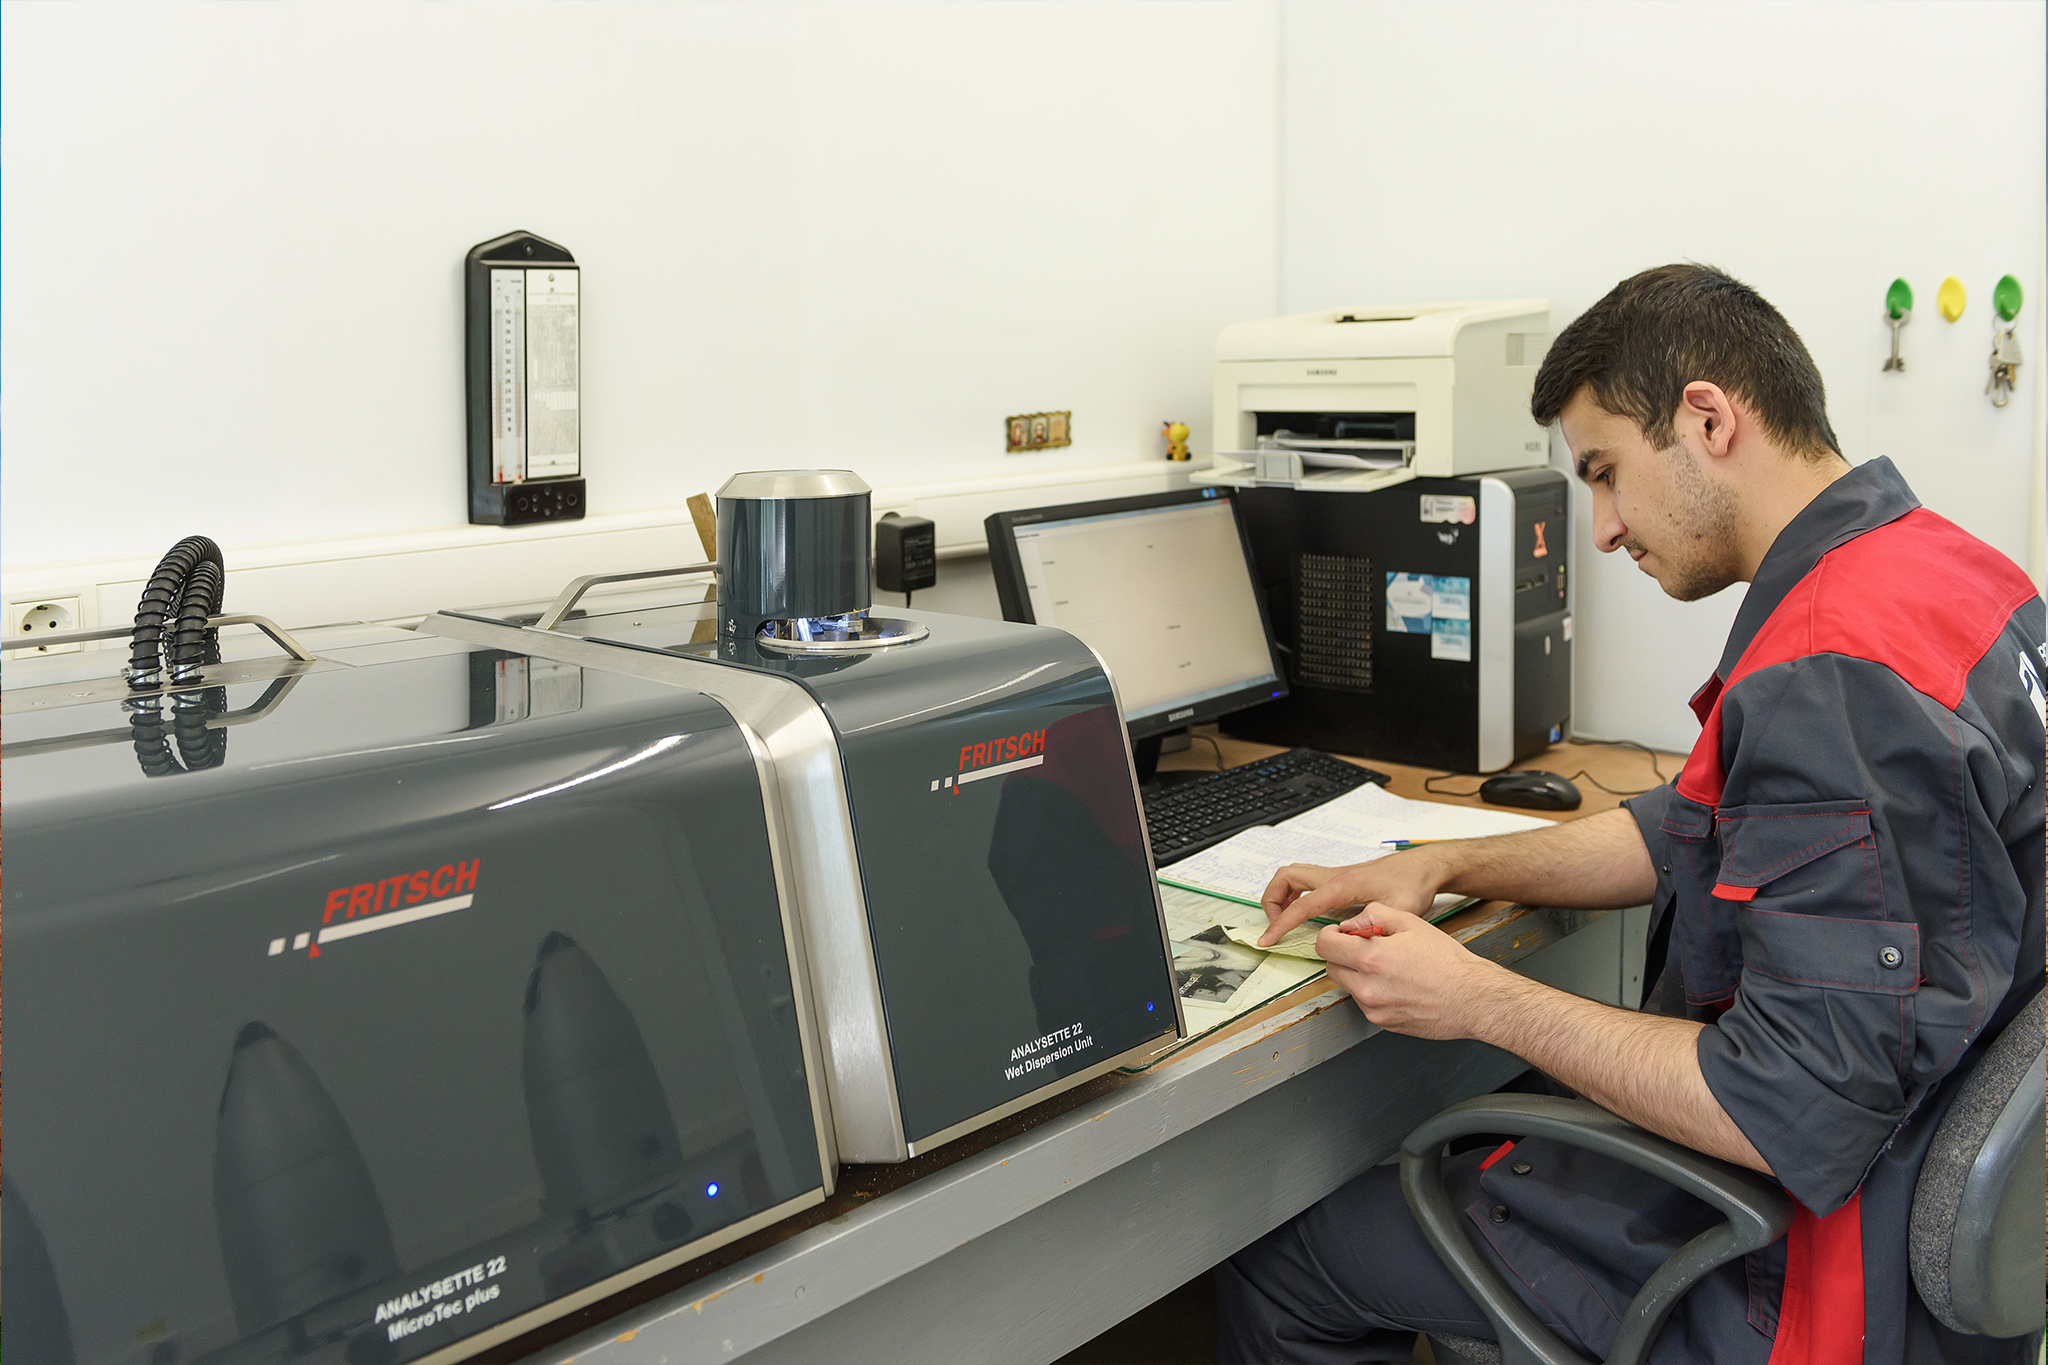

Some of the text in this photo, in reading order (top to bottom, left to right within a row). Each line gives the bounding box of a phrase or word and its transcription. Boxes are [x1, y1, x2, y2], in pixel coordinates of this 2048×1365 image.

[1168, 708, 1194, 722] SAMSUNG
[959, 729, 1046, 771] FRITSCH
[322, 858, 481, 924] FRITSCH
[1004, 1035, 1094, 1081] Wet Dispersion Unit
[1011, 1022, 1084, 1062] ANALYSETTE 22
[374, 1255, 507, 1324] ANALYSETTE 22
[387, 1283, 501, 1342] MicroTec plus
